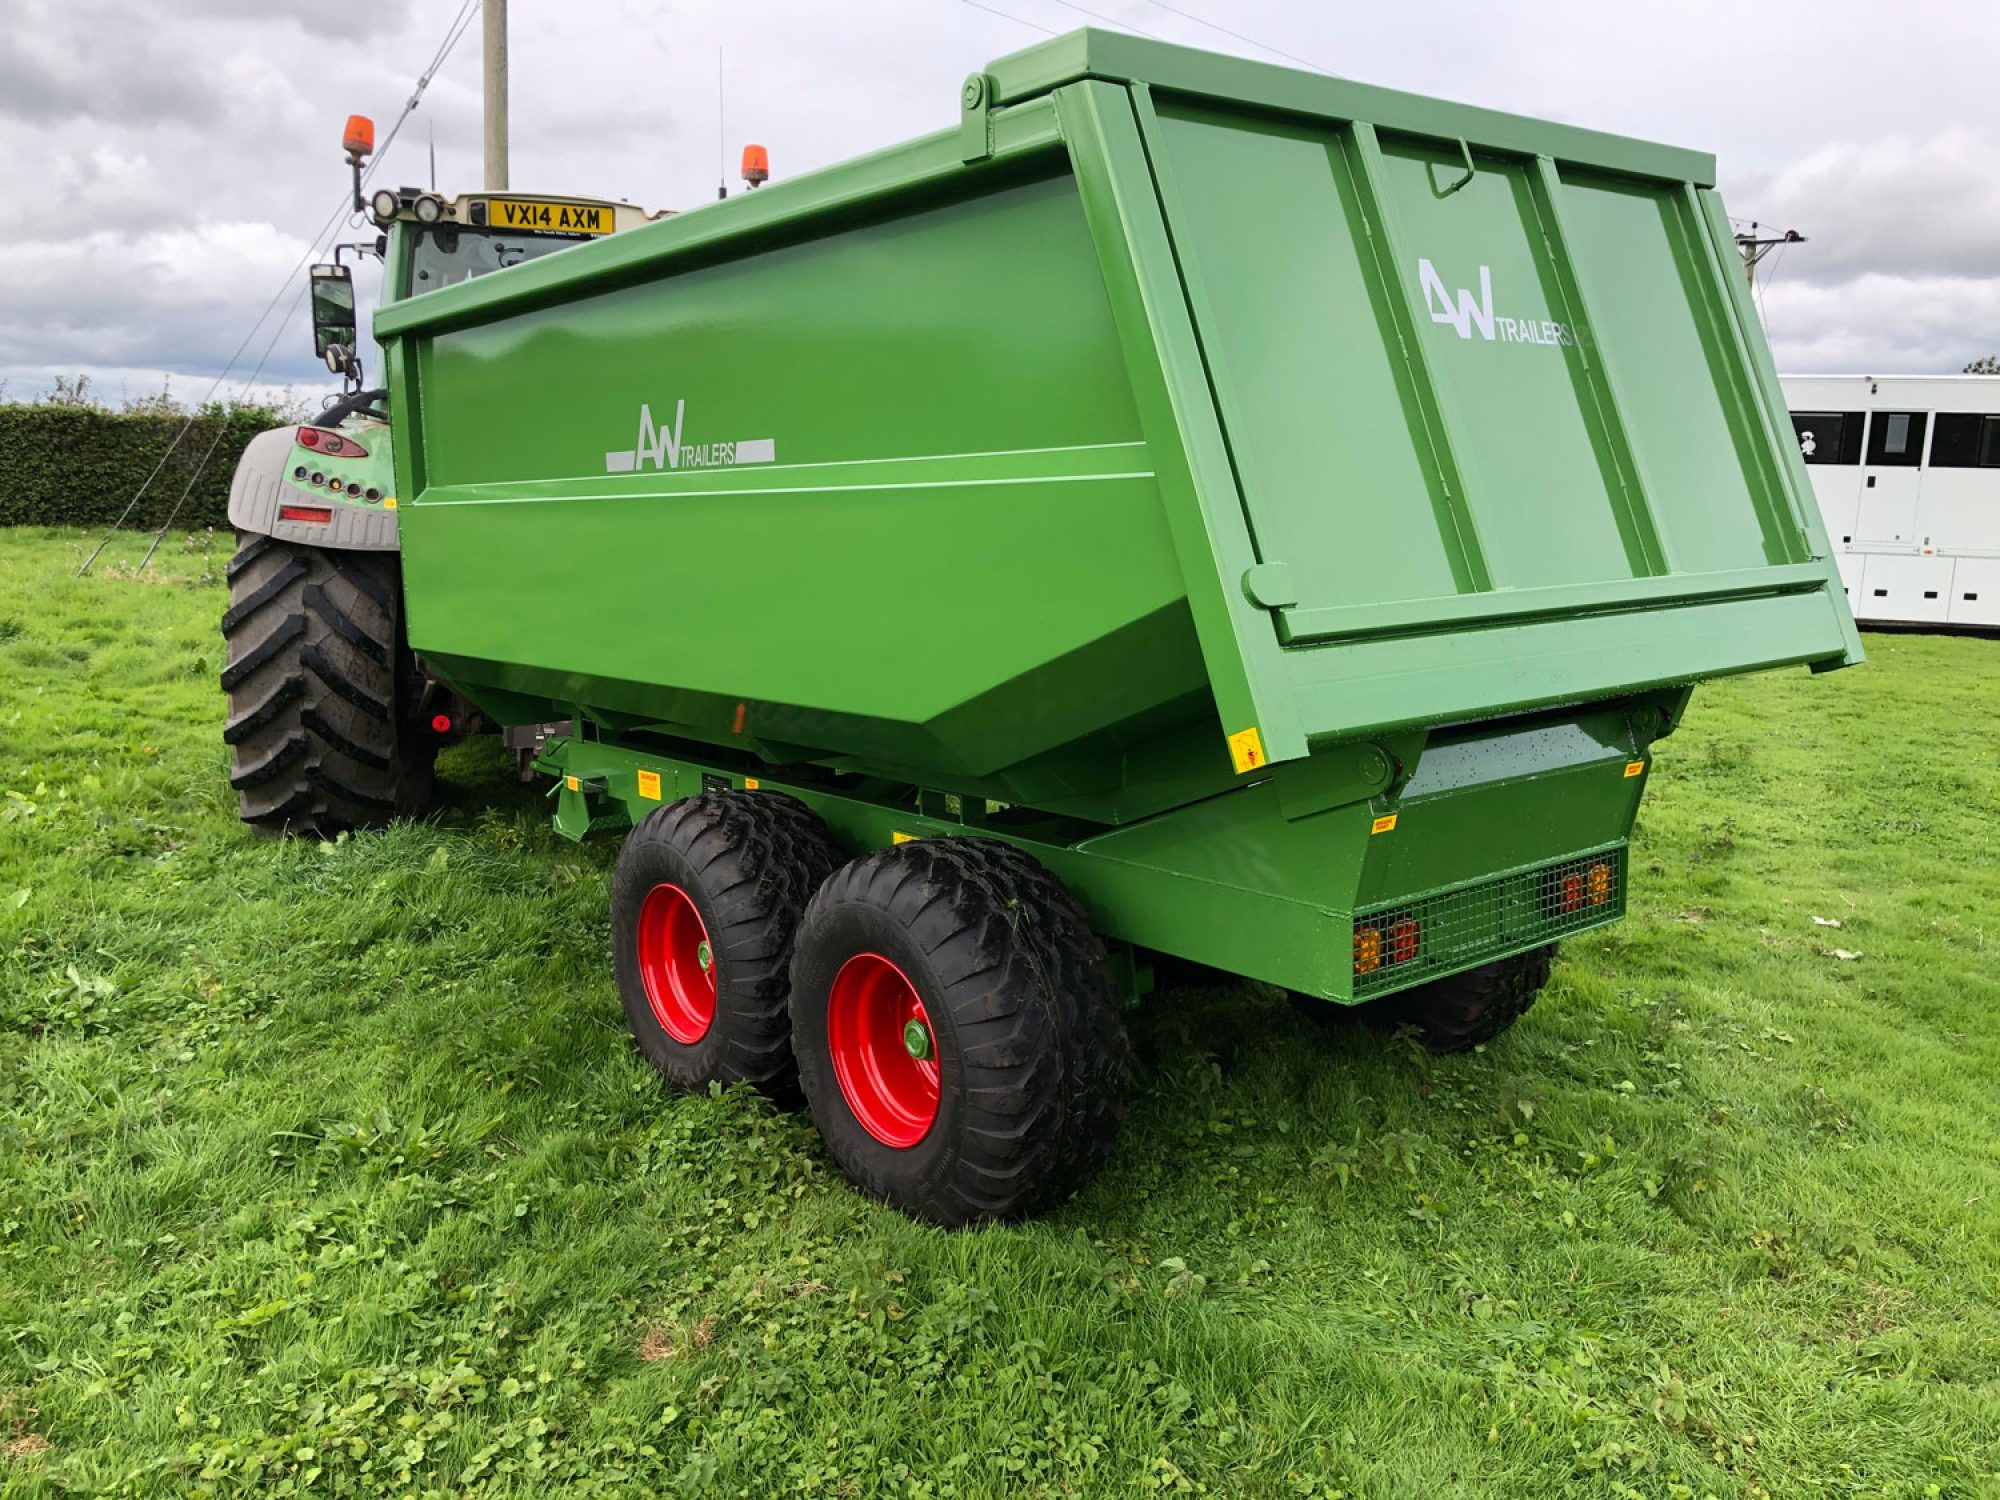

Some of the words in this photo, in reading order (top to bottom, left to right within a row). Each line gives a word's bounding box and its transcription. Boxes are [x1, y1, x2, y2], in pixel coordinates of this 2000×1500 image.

[503, 203, 551, 226] VX14
[559, 207, 600, 229] AXM
[1418, 258, 1496, 341] AW
[1495, 316, 1573, 346] TRAILERS
[635, 399, 685, 471] AW
[680, 442, 735, 468] TRAILERS
